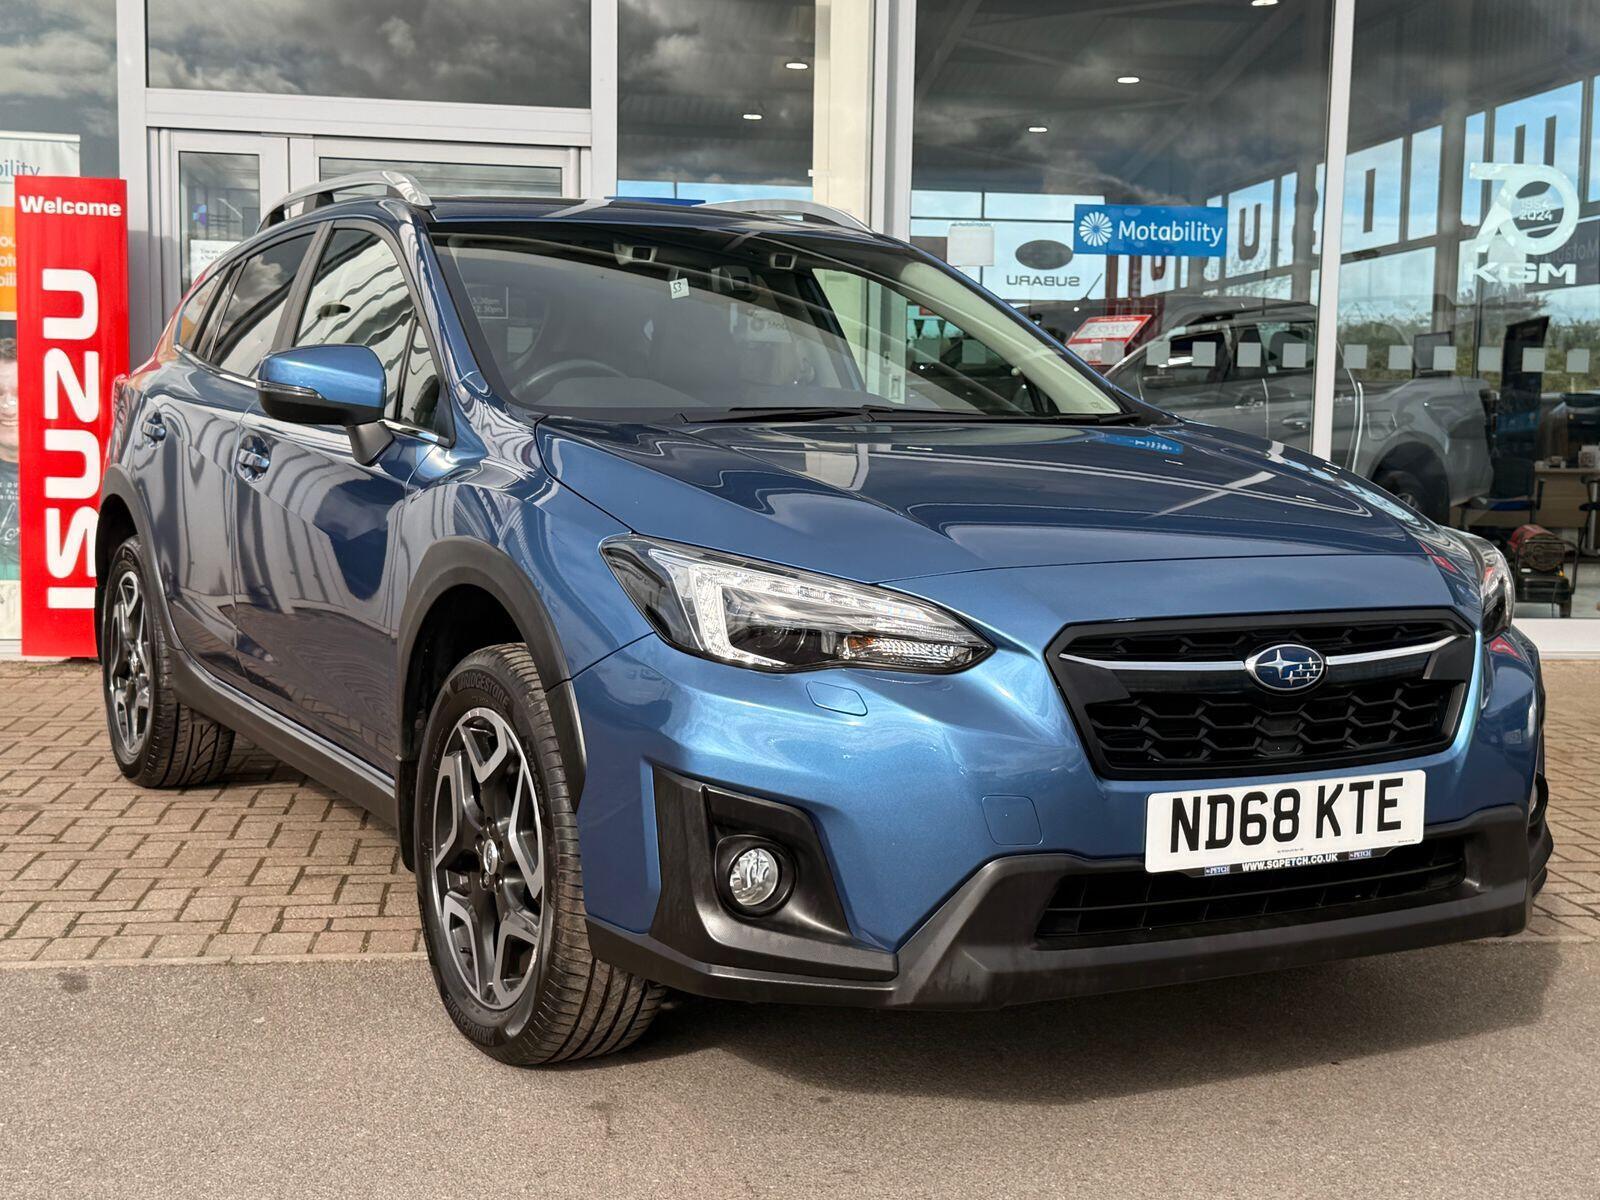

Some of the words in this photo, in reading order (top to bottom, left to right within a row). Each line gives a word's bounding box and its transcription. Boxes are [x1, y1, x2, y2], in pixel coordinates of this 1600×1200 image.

[19, 195, 122, 217] Welcome
[1519, 209, 1553, 221] 2024
[1118, 218, 1224, 248] Motability
[1464, 262, 1577, 285] KGM
[42, 268, 100, 609] ISUZU
[1170, 788, 1301, 853] ND68
[1315, 778, 1404, 839] KTE
[1241, 852, 1339, 872] WWW.SGPETCH.CO.UK
